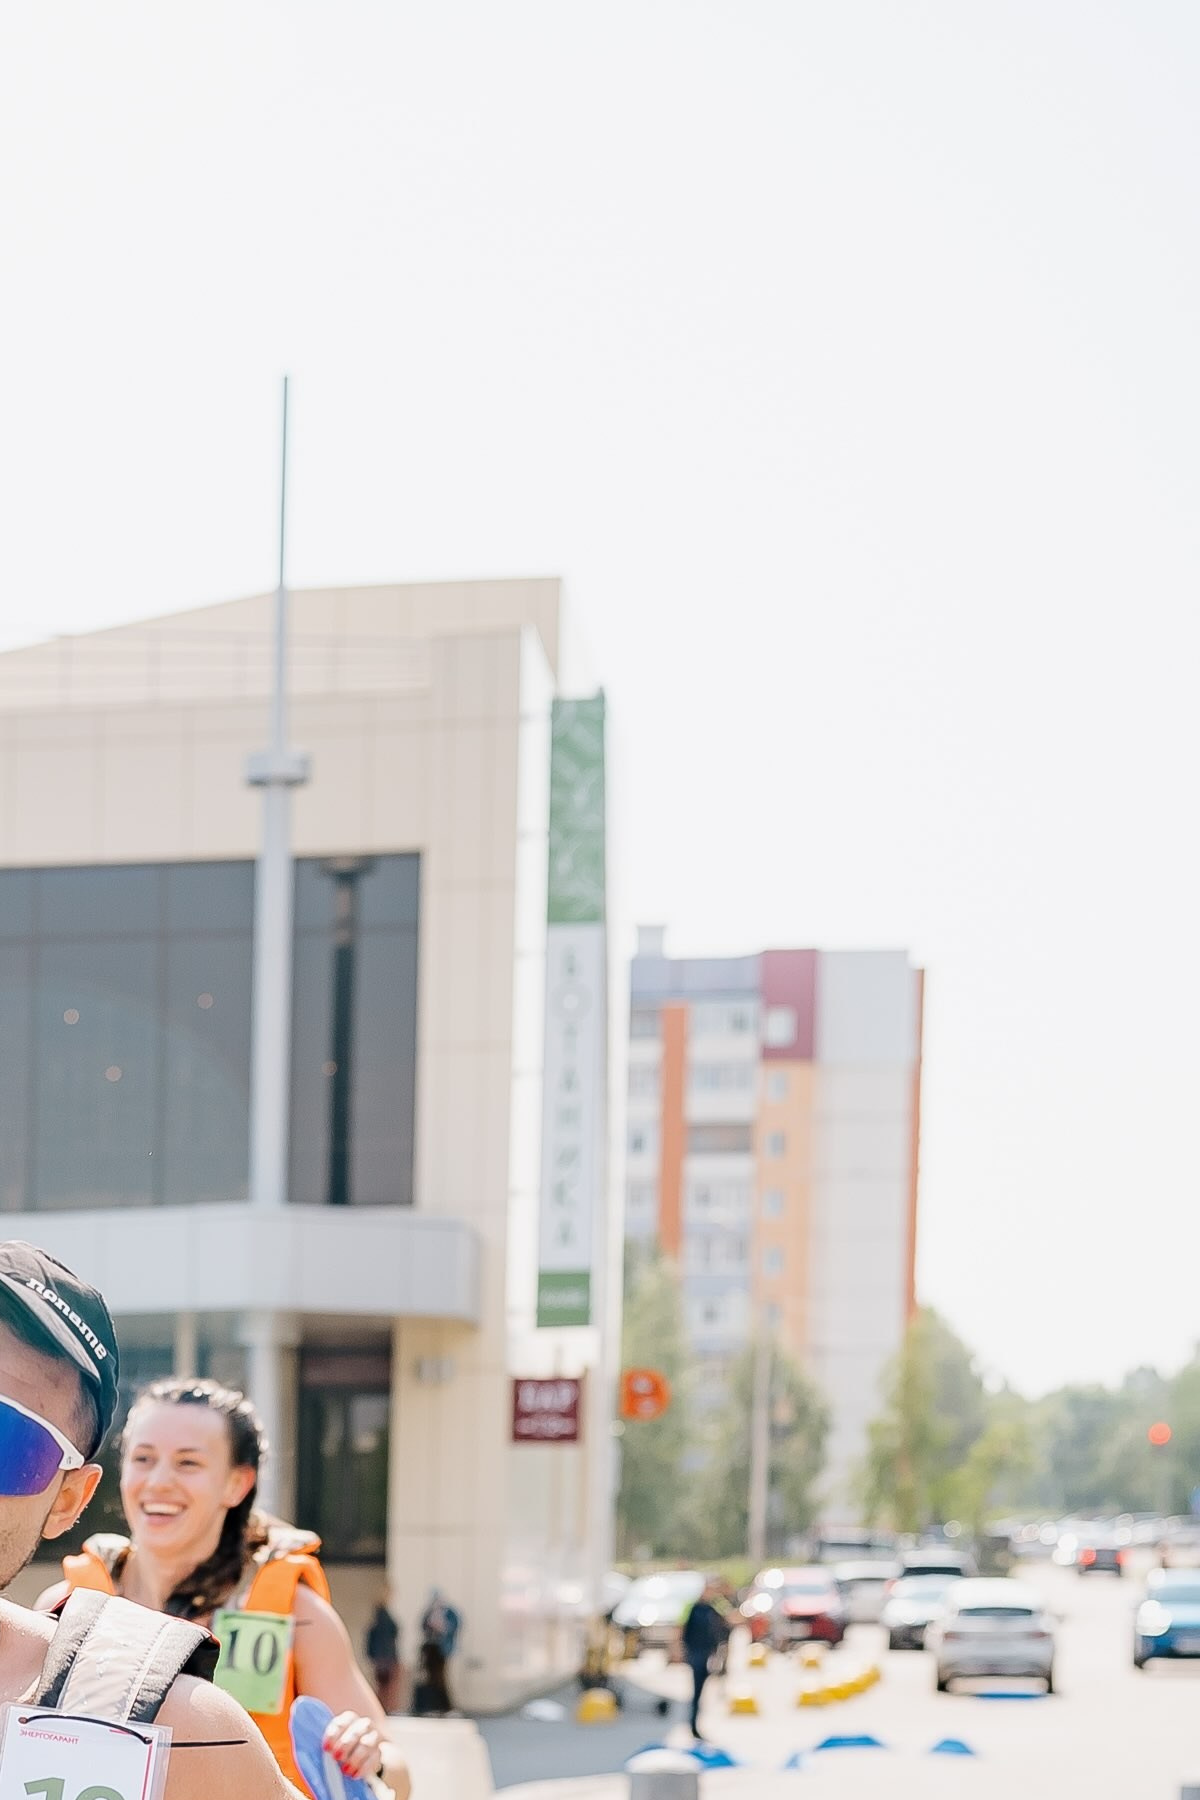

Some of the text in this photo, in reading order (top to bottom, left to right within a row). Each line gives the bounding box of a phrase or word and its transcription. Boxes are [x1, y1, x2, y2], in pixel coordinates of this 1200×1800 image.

[26, 1278, 108, 1360] noname
[224, 1628, 279, 1676] 10
[19, 1729, 79, 1745] ЭНЕРГОГАРАНТ
